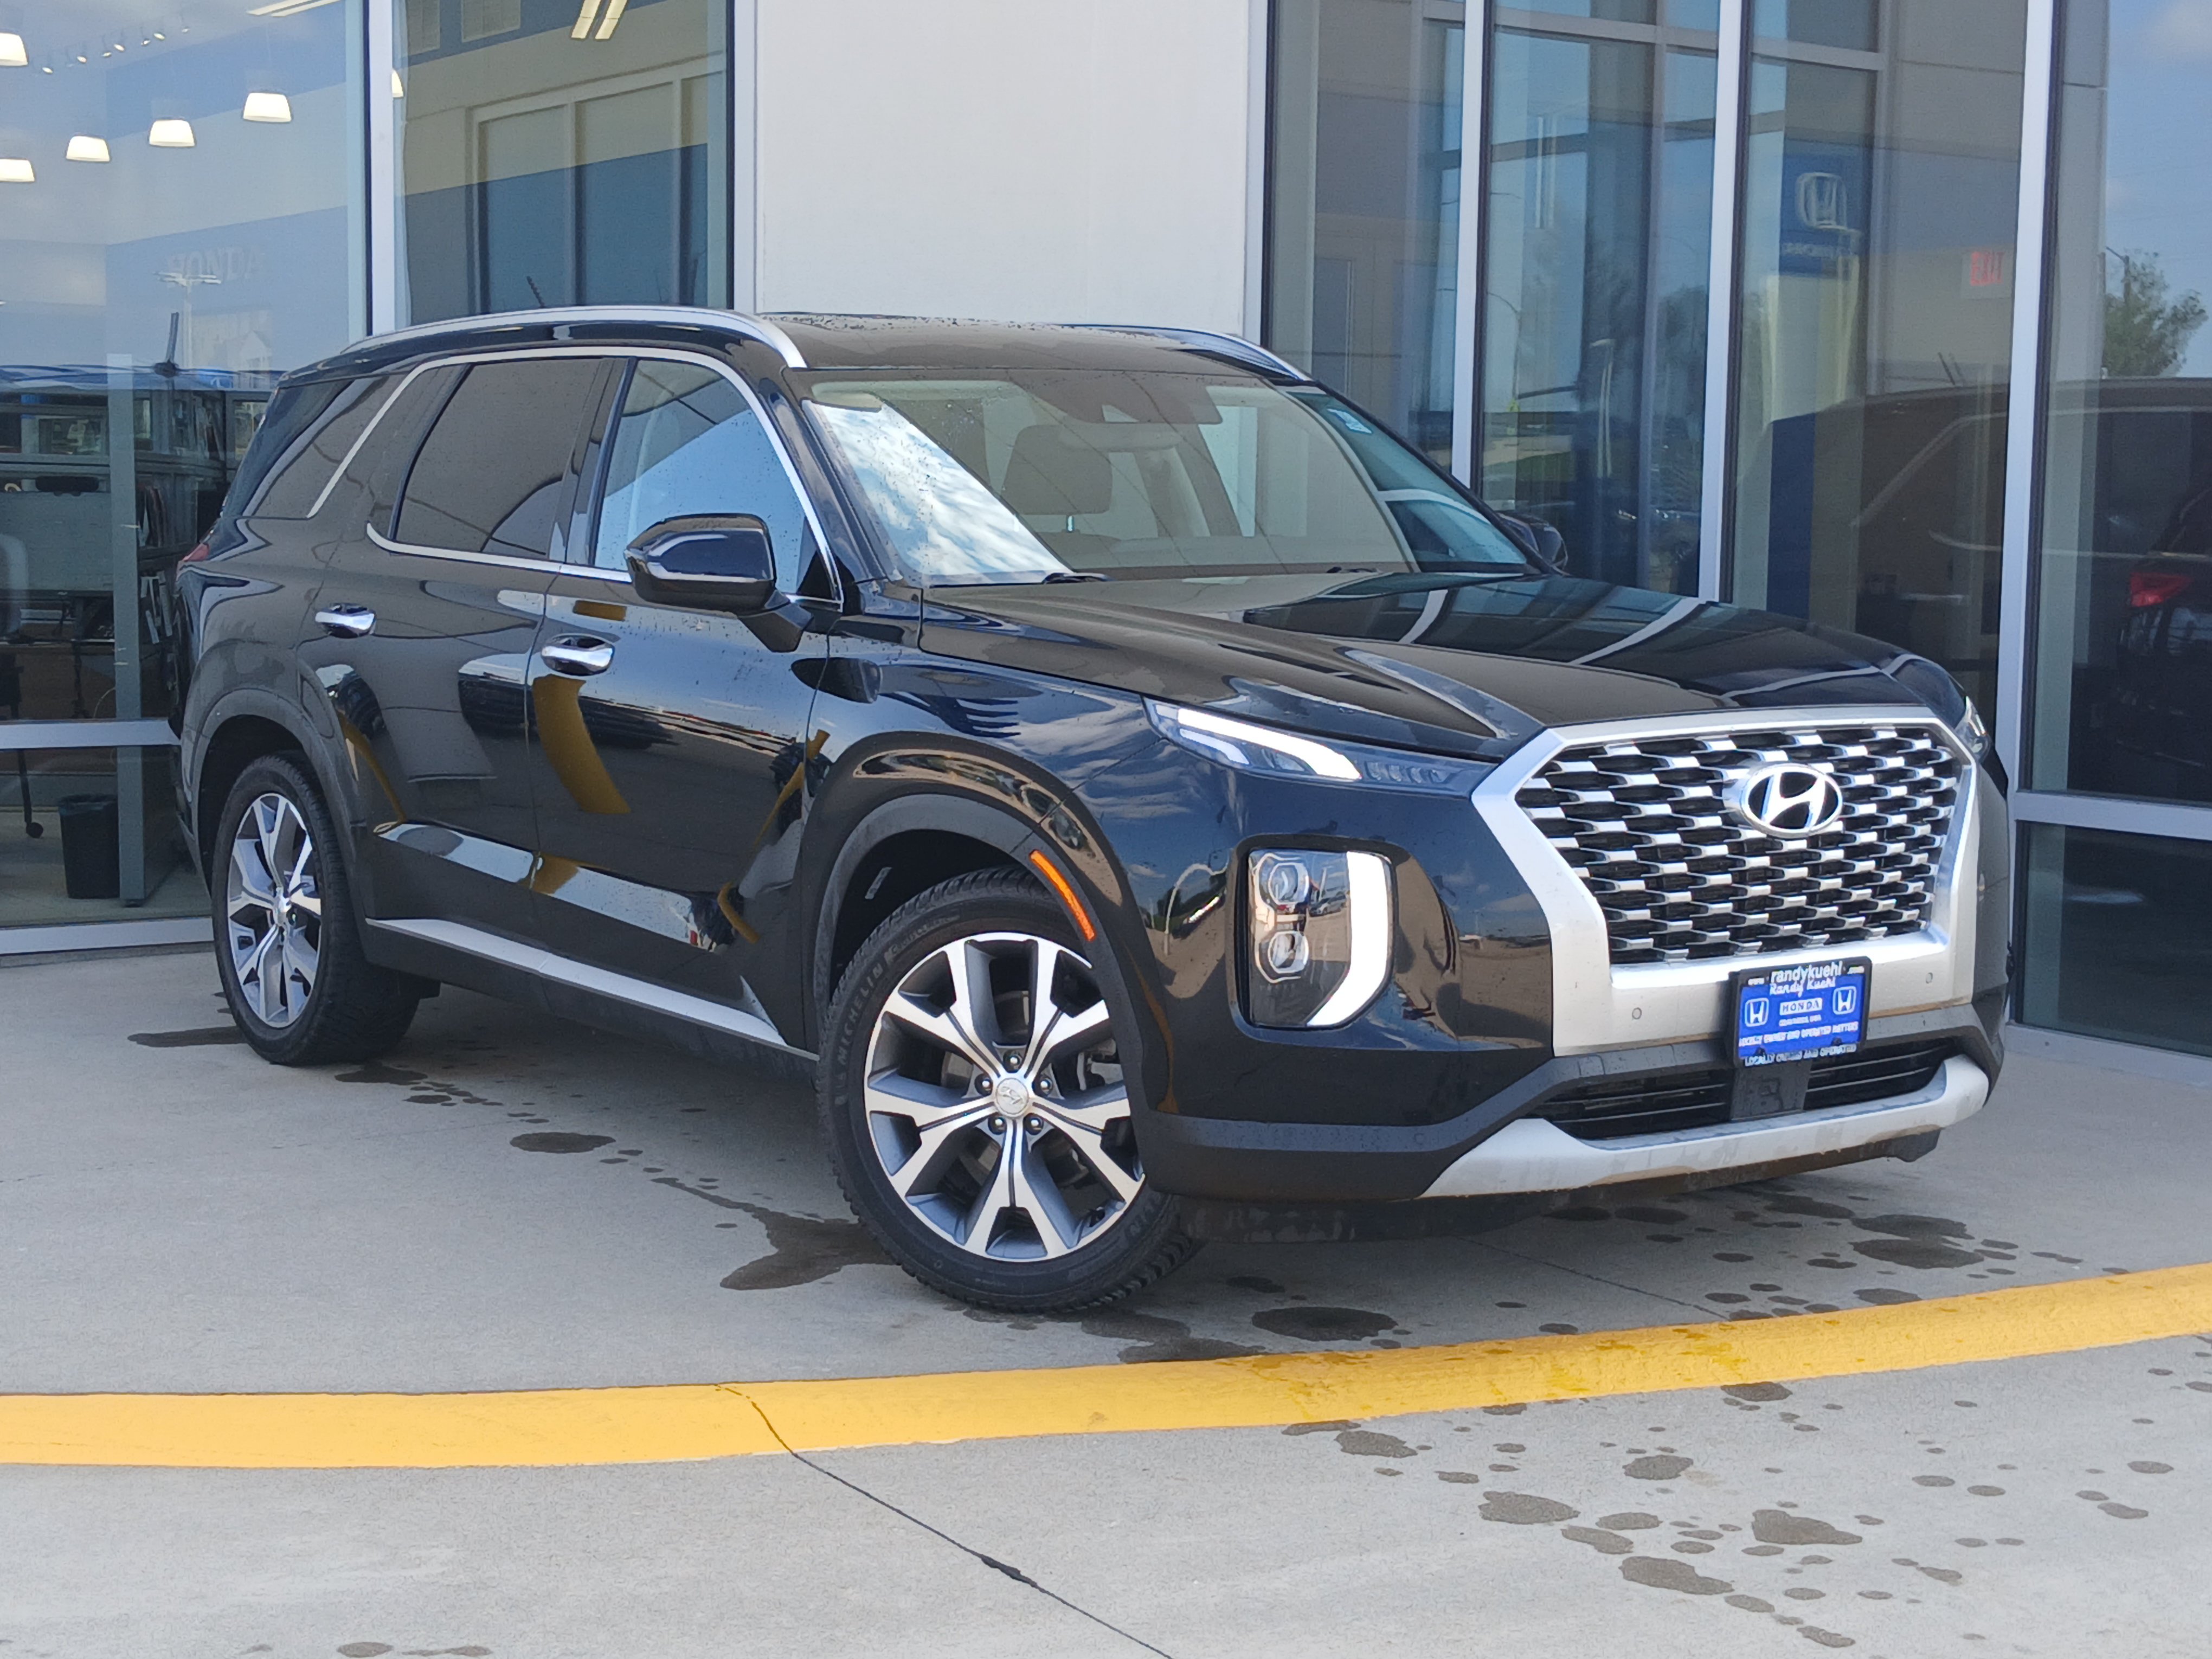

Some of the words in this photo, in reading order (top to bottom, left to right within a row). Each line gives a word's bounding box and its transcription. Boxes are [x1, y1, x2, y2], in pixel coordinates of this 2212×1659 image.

[1970, 251, 2004, 286] EXIT
[837, 962, 885, 1066] MICHELIN
[1782, 1000, 1819, 1013] HONDA
